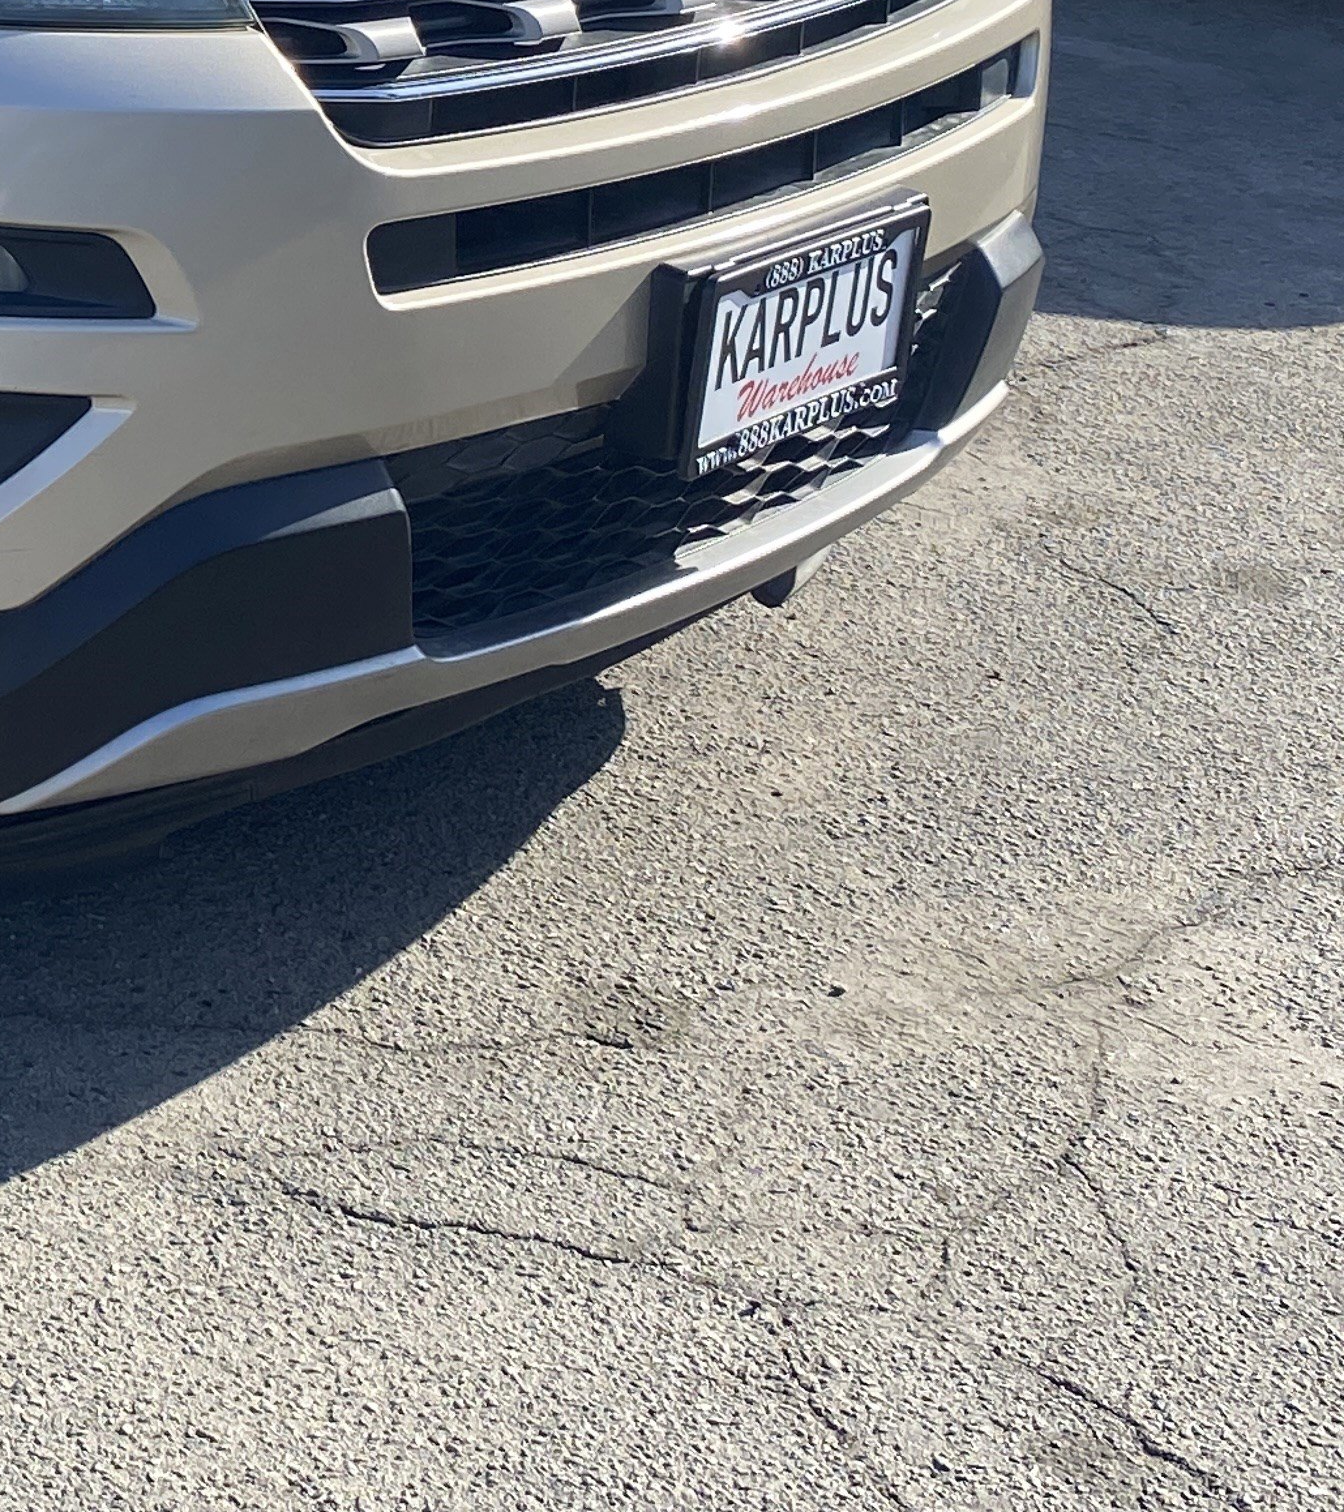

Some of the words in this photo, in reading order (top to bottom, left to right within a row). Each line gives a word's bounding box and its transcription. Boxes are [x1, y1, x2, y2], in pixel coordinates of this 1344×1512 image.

[765, 257, 805, 289] (888)
[807, 229, 887, 275] KARPLUS
[715, 248, 898, 392] KARPLUS
[736, 352, 860, 422] Warehouse
